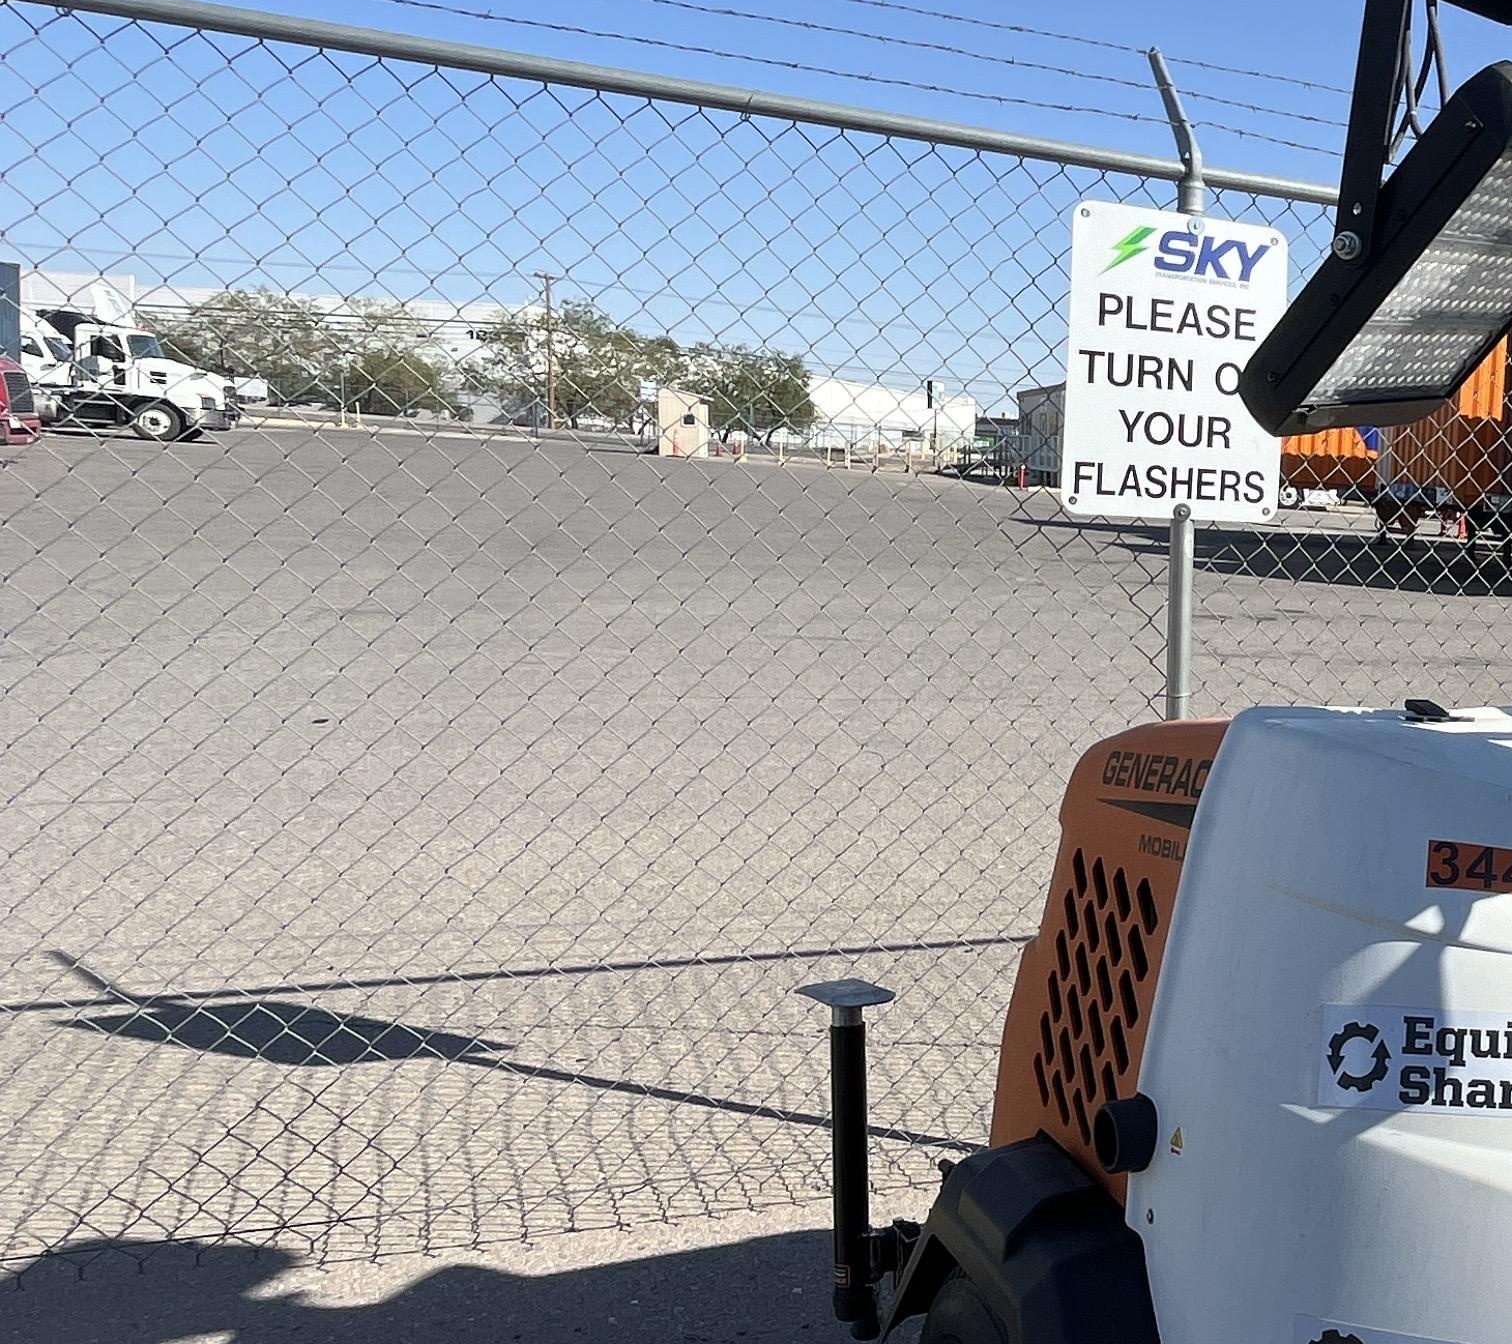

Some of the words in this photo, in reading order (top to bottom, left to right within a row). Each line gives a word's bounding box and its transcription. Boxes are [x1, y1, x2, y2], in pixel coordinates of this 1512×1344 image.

[1154, 230, 1270, 283] SKY
[1098, 292, 1257, 342] PLEASE
[1078, 349, 1194, 392] TURN
[1118, 409, 1232, 449] YOUR
[1073, 461, 1265, 504] FLASHERS
[1138, 833, 1188, 862] MOBIL
